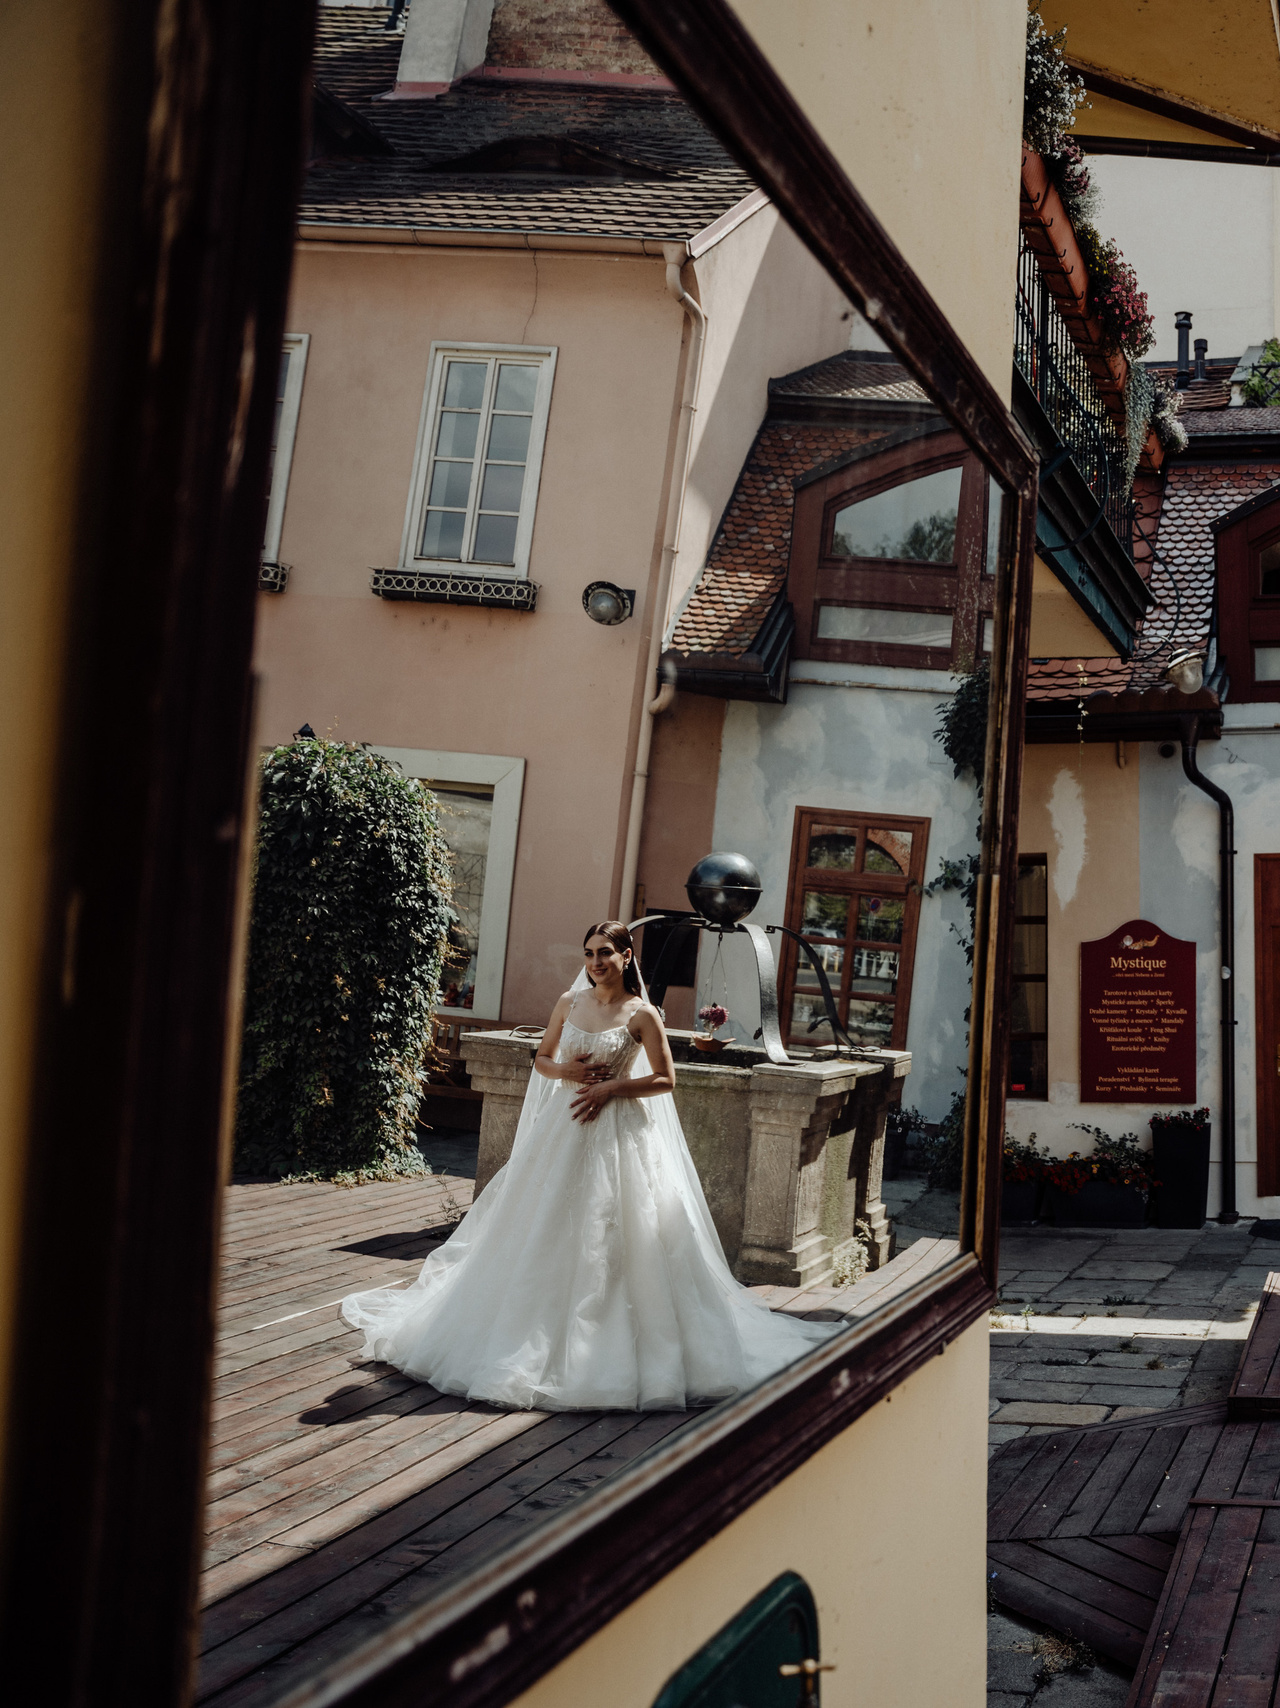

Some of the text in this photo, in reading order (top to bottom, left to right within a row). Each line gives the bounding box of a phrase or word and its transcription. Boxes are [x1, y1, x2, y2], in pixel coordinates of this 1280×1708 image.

[1110, 956, 1167, 971] Mystique
[1158, 989, 1173, 997] karty
[1101, 998, 1175, 1006] Mystické amulety Šperky
[1089, 1007, 1188, 1015] Drahé kameny Krystaly Kyvadla
[1150, 1026, 1164, 1034] Feng
[1153, 1035, 1170, 1043] Knihy
